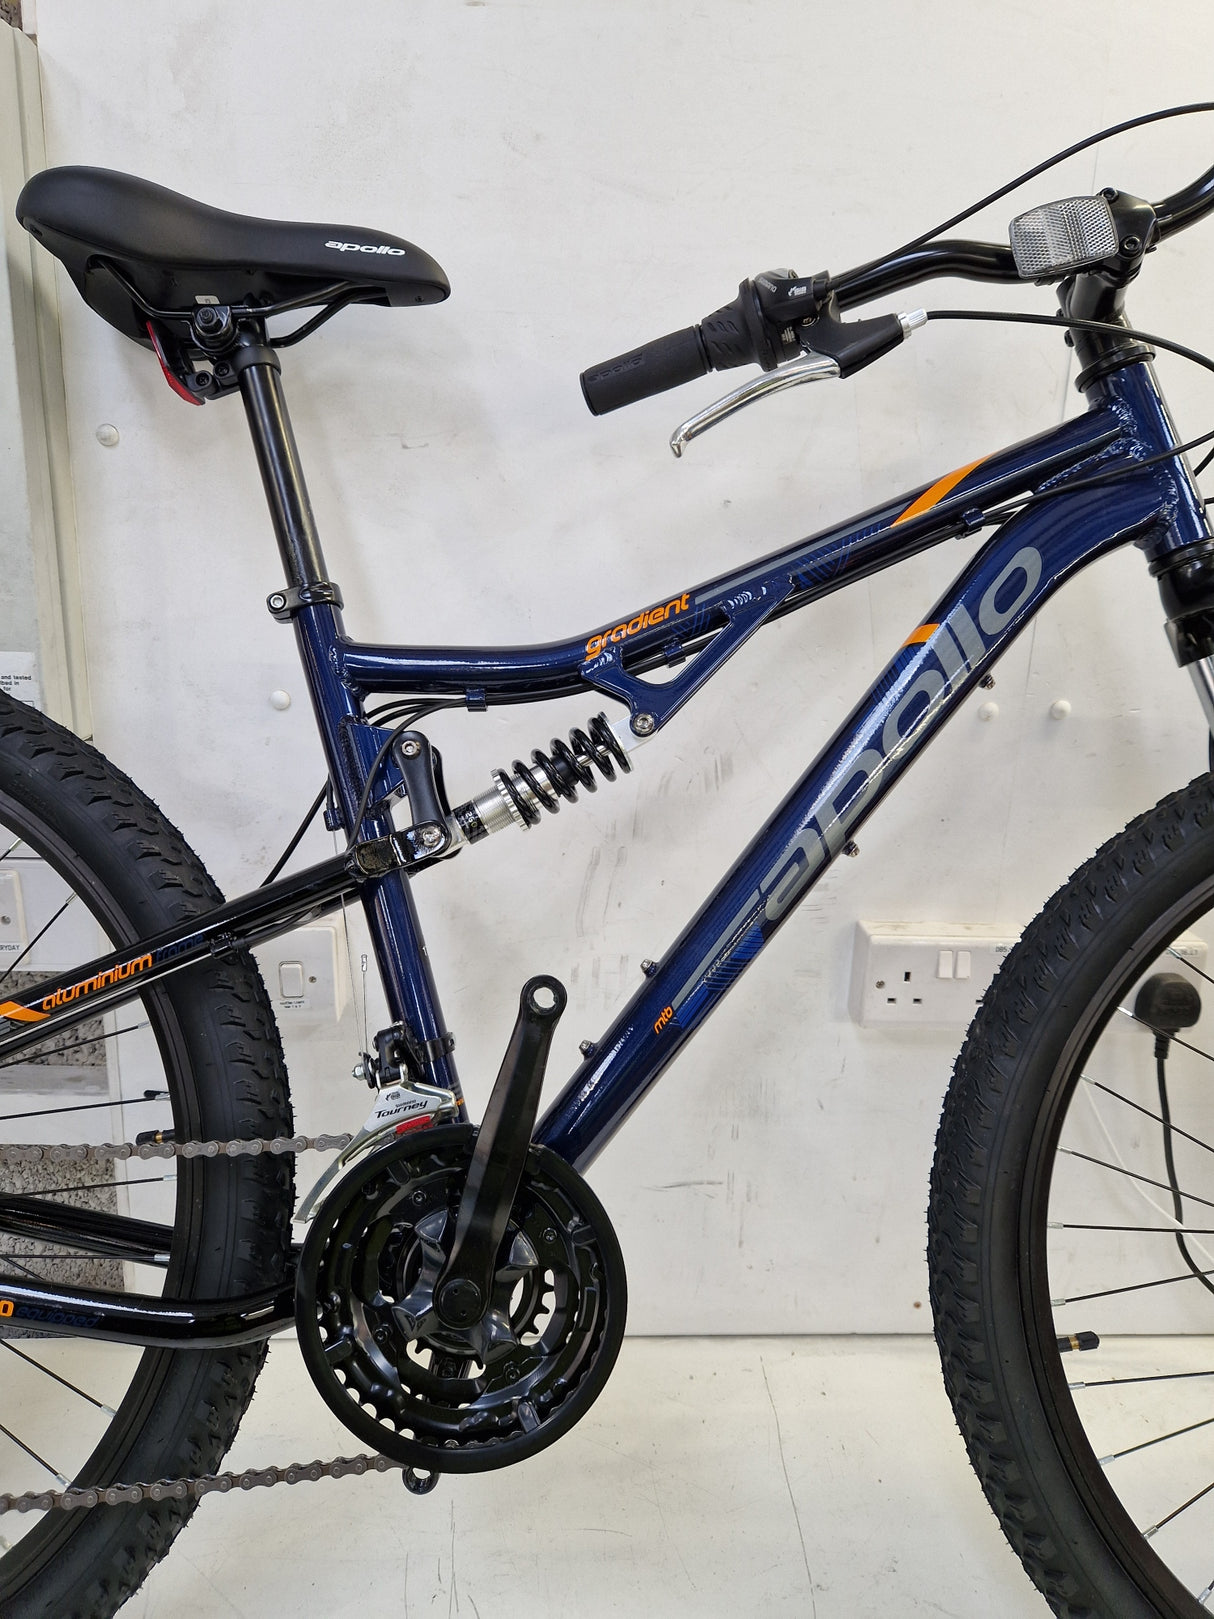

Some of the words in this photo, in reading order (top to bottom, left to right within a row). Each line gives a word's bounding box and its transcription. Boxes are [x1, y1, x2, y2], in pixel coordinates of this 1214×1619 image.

[324, 240, 406, 256] apollo
[585, 593, 690, 661] gradient
[765, 546, 1043, 921] apollo
[42, 953, 152, 1011] aluminium
[653, 1006, 673, 1035] mtb
[375, 1100, 428, 1118] Tourney
[16, 1305, 101, 1328] equipped
